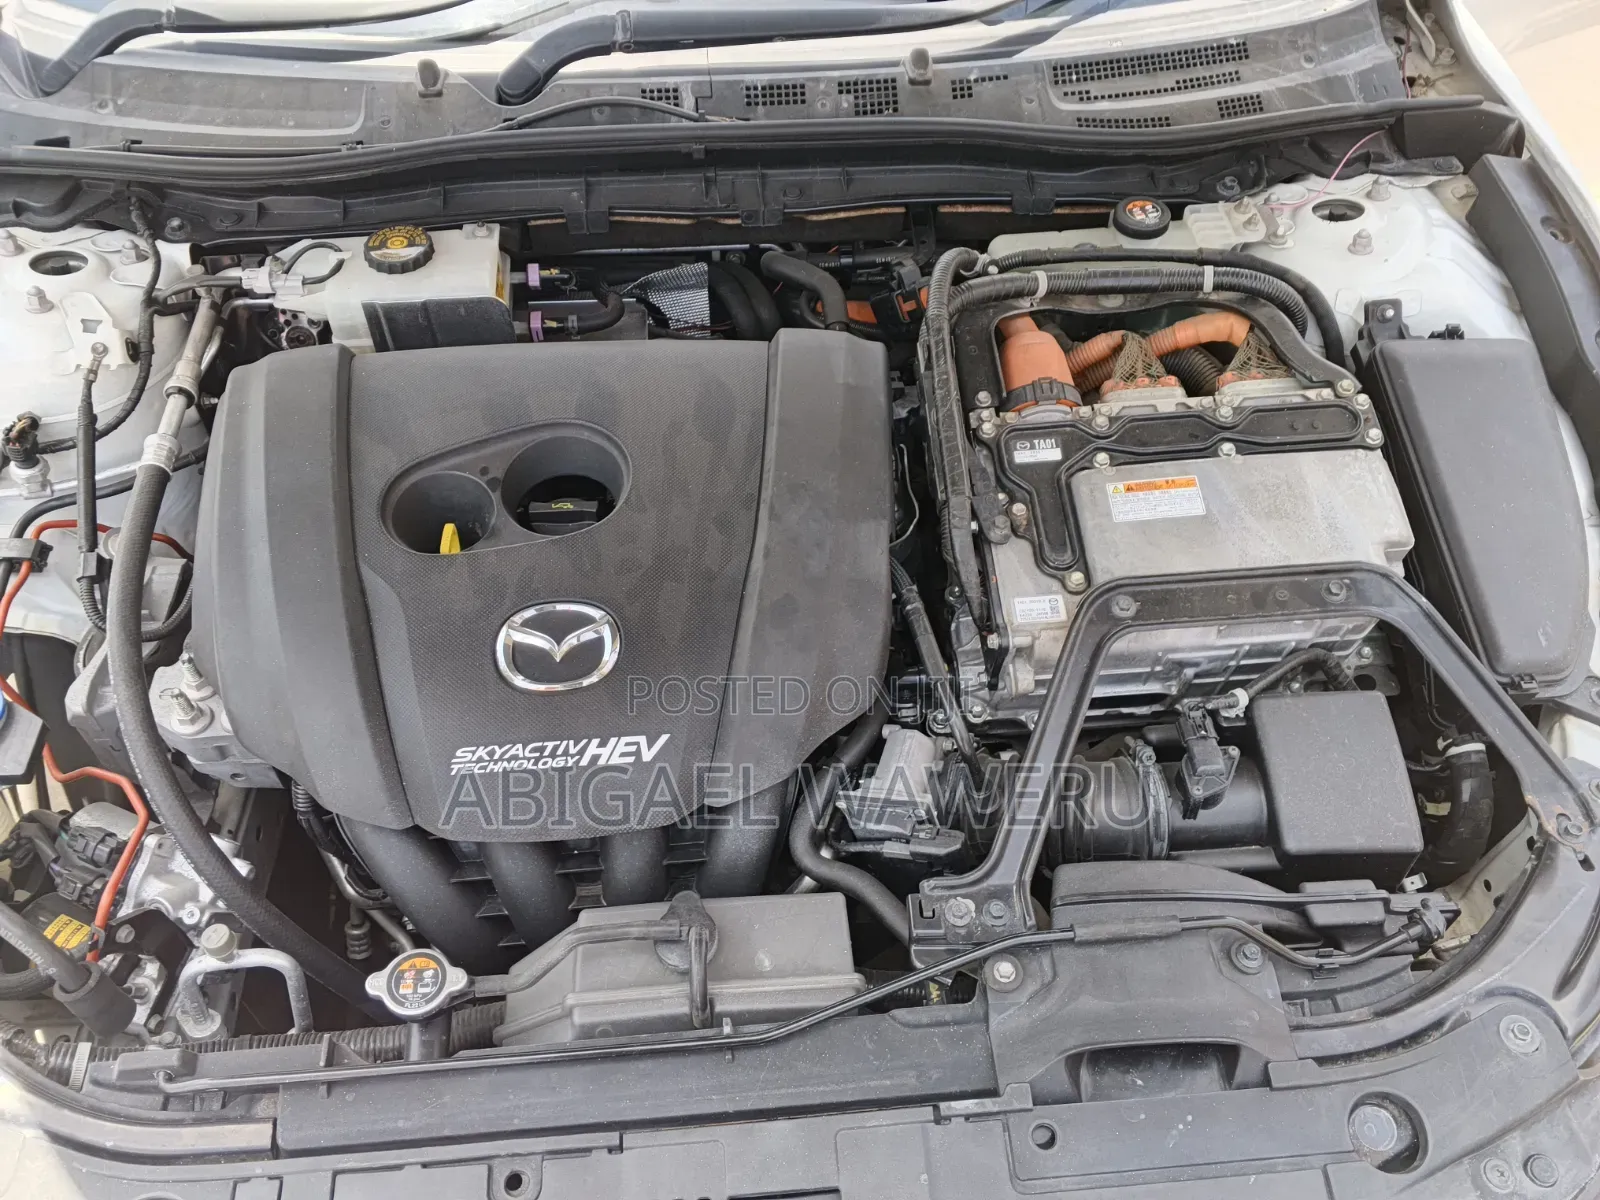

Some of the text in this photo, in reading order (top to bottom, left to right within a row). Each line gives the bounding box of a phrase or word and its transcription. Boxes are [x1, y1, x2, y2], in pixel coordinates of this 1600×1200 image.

[1033, 438, 1056, 450] TA01
[450, 733, 672, 767] SKYACTIV HEV
[450, 755, 581, 776] TECHNOLOGY
